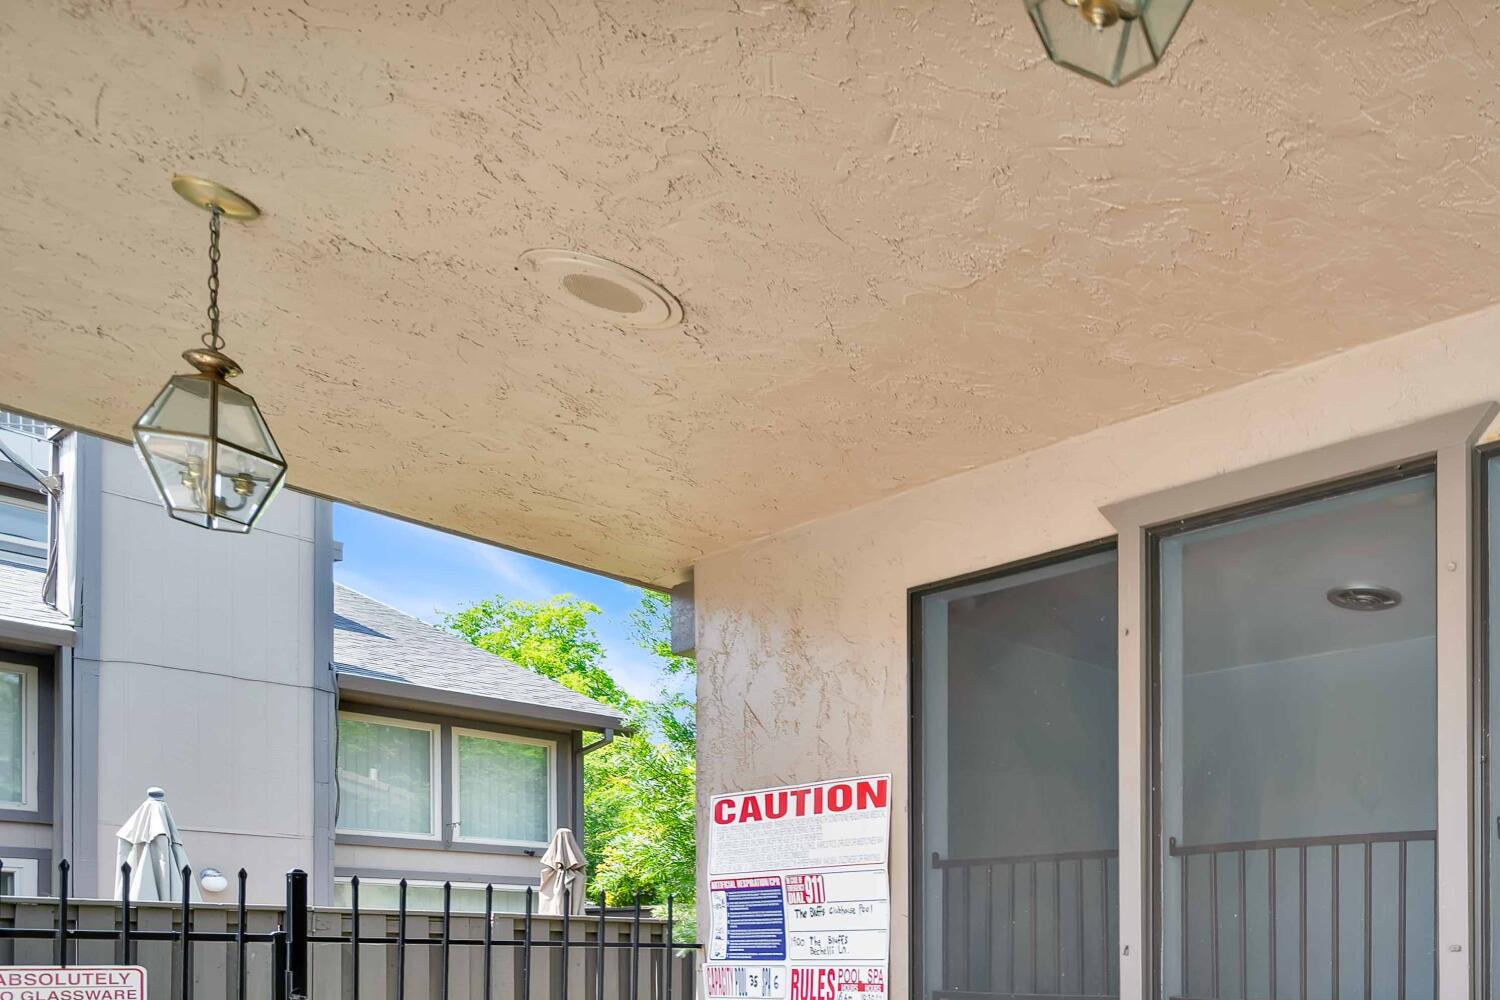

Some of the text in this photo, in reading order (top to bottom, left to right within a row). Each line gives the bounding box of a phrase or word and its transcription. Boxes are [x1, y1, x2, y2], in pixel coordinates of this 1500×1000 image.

[713, 779, 887, 825] CAUTION
[804, 875, 825, 904] 911
[794, 908, 807, 919] The
[858, 903, 873, 915] Pool
[809, 936, 821, 946] The
[707, 967, 733, 996] CAPACITY
[734, 967, 748, 996] POOL
[749, 975, 758, 988] 35
[773, 975, 779, 989] 6
[838, 968, 862, 984] POOL
[867, 968, 884, 984] SPA
